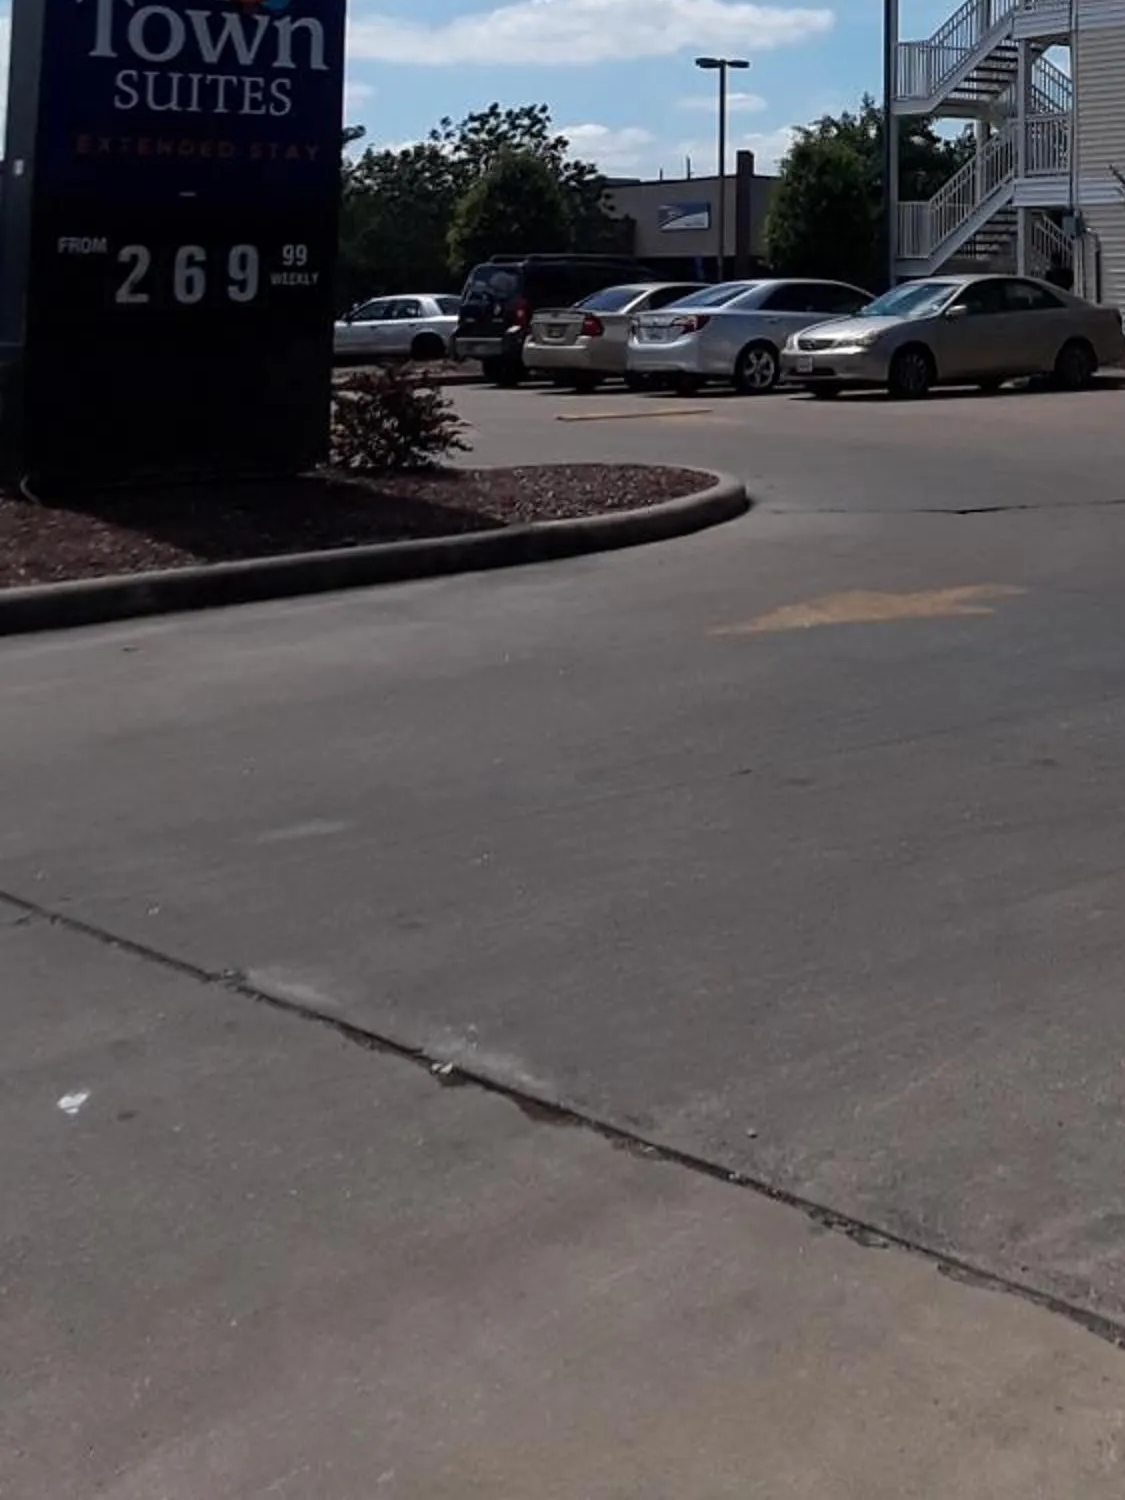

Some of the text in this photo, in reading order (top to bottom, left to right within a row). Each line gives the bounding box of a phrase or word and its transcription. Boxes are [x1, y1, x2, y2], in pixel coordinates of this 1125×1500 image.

[113, 69, 293, 117] SUITES
[75, 133, 321, 162] EXTENDED STAY
[56, 235, 109, 255] FROM
[280, 243, 309, 267] 99
[269, 271, 321, 287] WEEKLY
